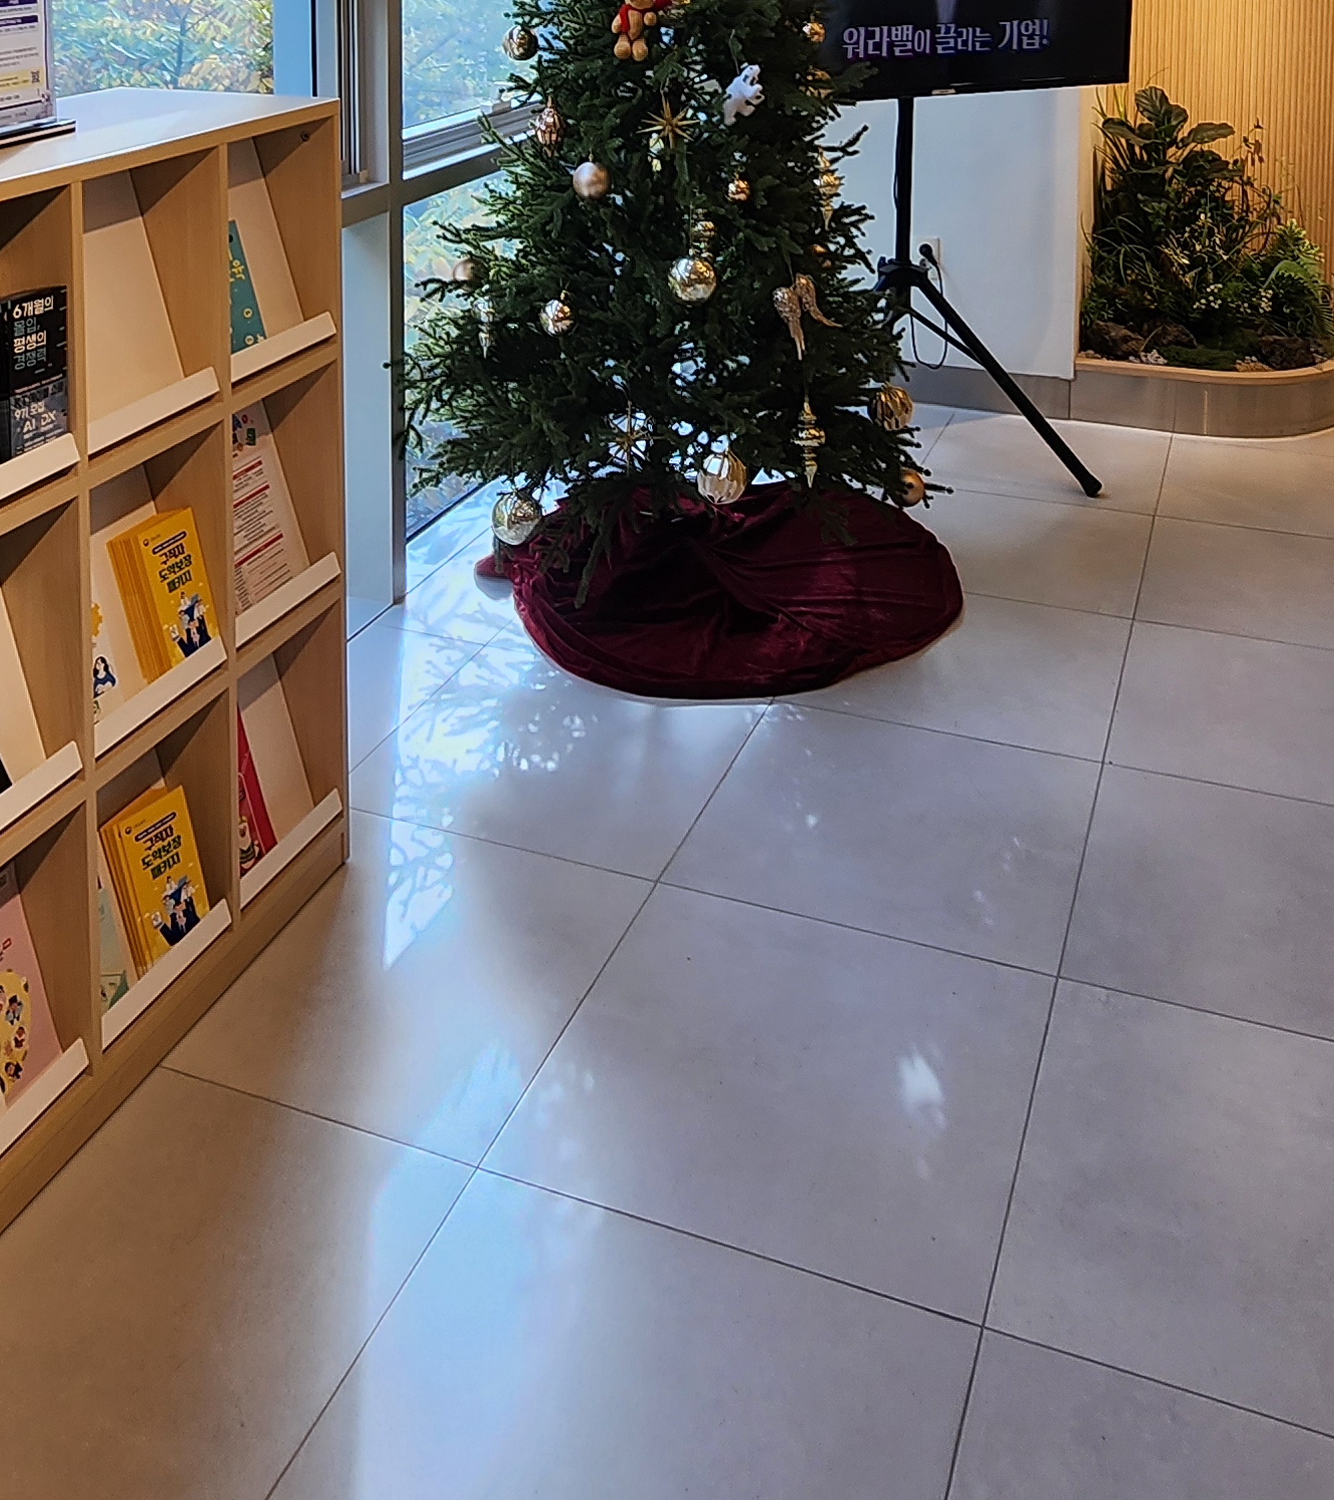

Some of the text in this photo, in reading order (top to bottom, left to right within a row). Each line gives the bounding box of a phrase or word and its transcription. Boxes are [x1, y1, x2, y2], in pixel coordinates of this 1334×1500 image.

[842, 18, 1051, 59] 워라밸이 끌리는 기업!
[12, 295, 55, 320] 6개월의
[13, 331, 48, 355] 평생의
